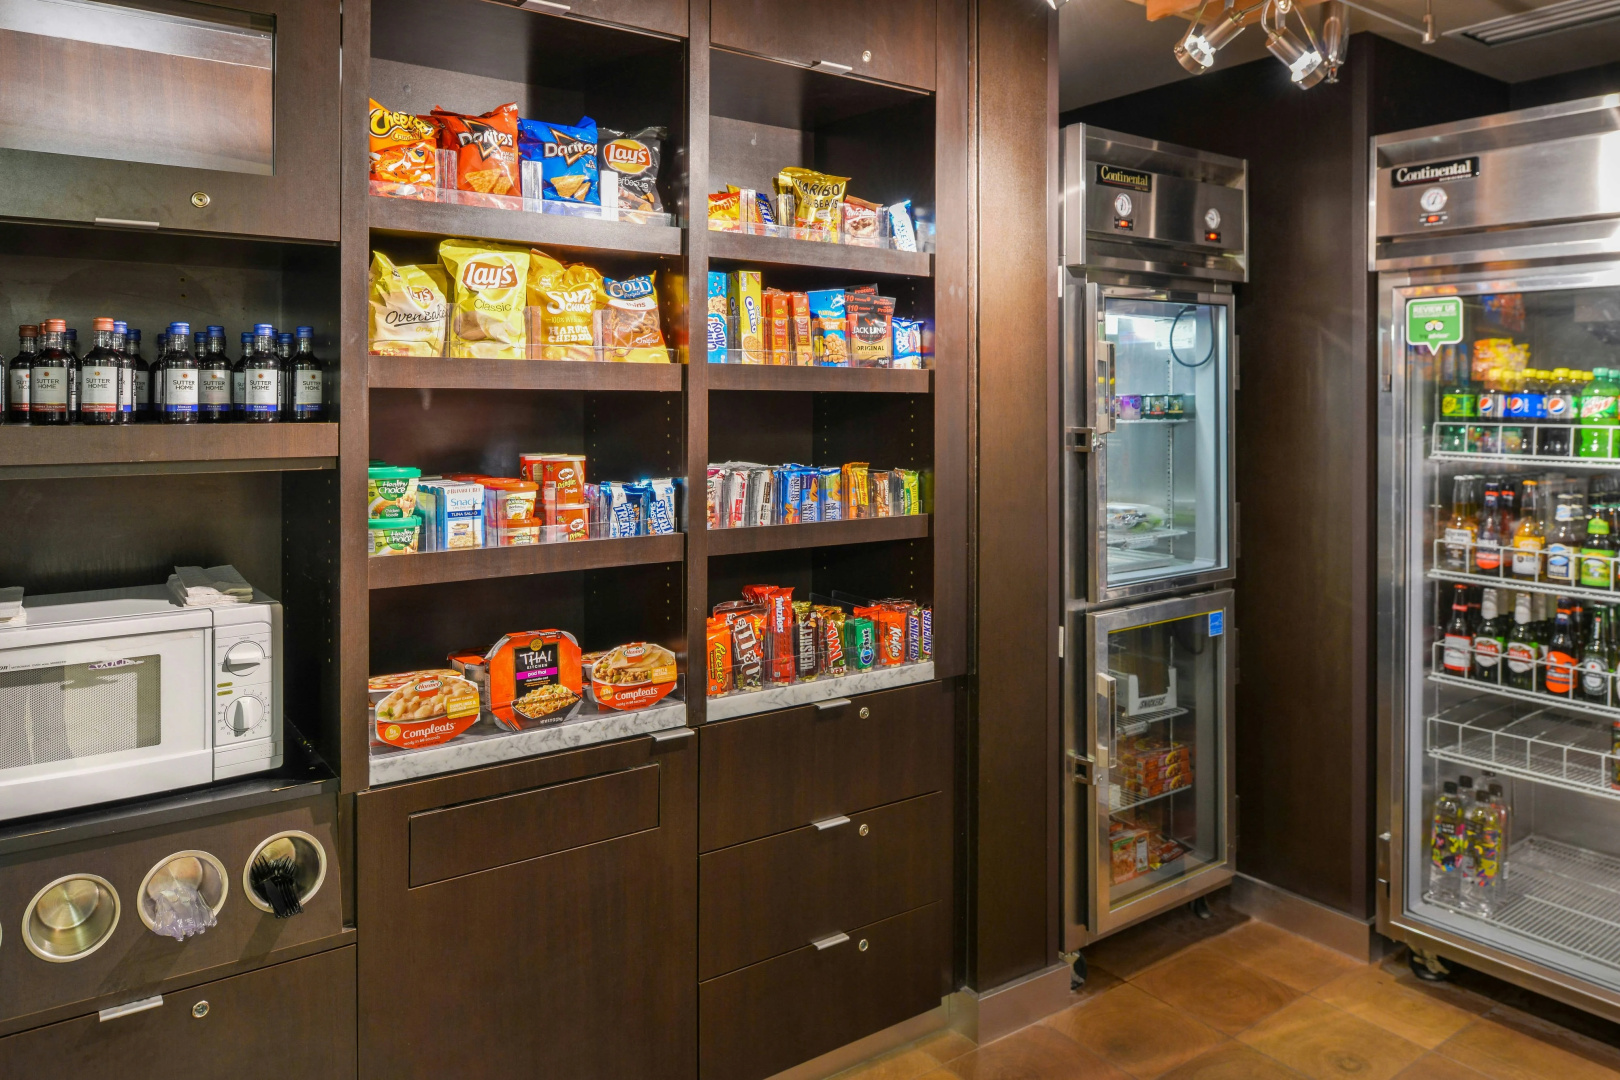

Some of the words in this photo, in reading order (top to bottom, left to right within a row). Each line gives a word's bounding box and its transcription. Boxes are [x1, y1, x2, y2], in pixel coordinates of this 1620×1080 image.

[608, 144, 648, 164] Lay's
[1100, 165, 1148, 187] Continental
[1396, 160, 1472, 182] Continental
[467, 263, 514, 289] Lay's
[610, 280, 652, 298] GOLD
[474, 298, 512, 312] Classic
[385, 310, 422, 324] Oven
[744, 296, 757, 334] OREO
[378, 486, 406, 494] Choice
[383, 480, 408, 488] Healthy
[450, 498, 478, 506] Snack
[656, 500, 674, 534] TREATS
[386, 536, 412, 544] Choice
[390, 529, 414, 537] Healthy
[910, 617, 919, 660] SNICKERS
[922, 610, 932, 653] SNICKERS
[826, 620, 843, 666] TWIX
[520, 650, 552, 665] THAI
[615, 687, 658, 700] Compleats
[403, 722, 454, 739] Compleats
